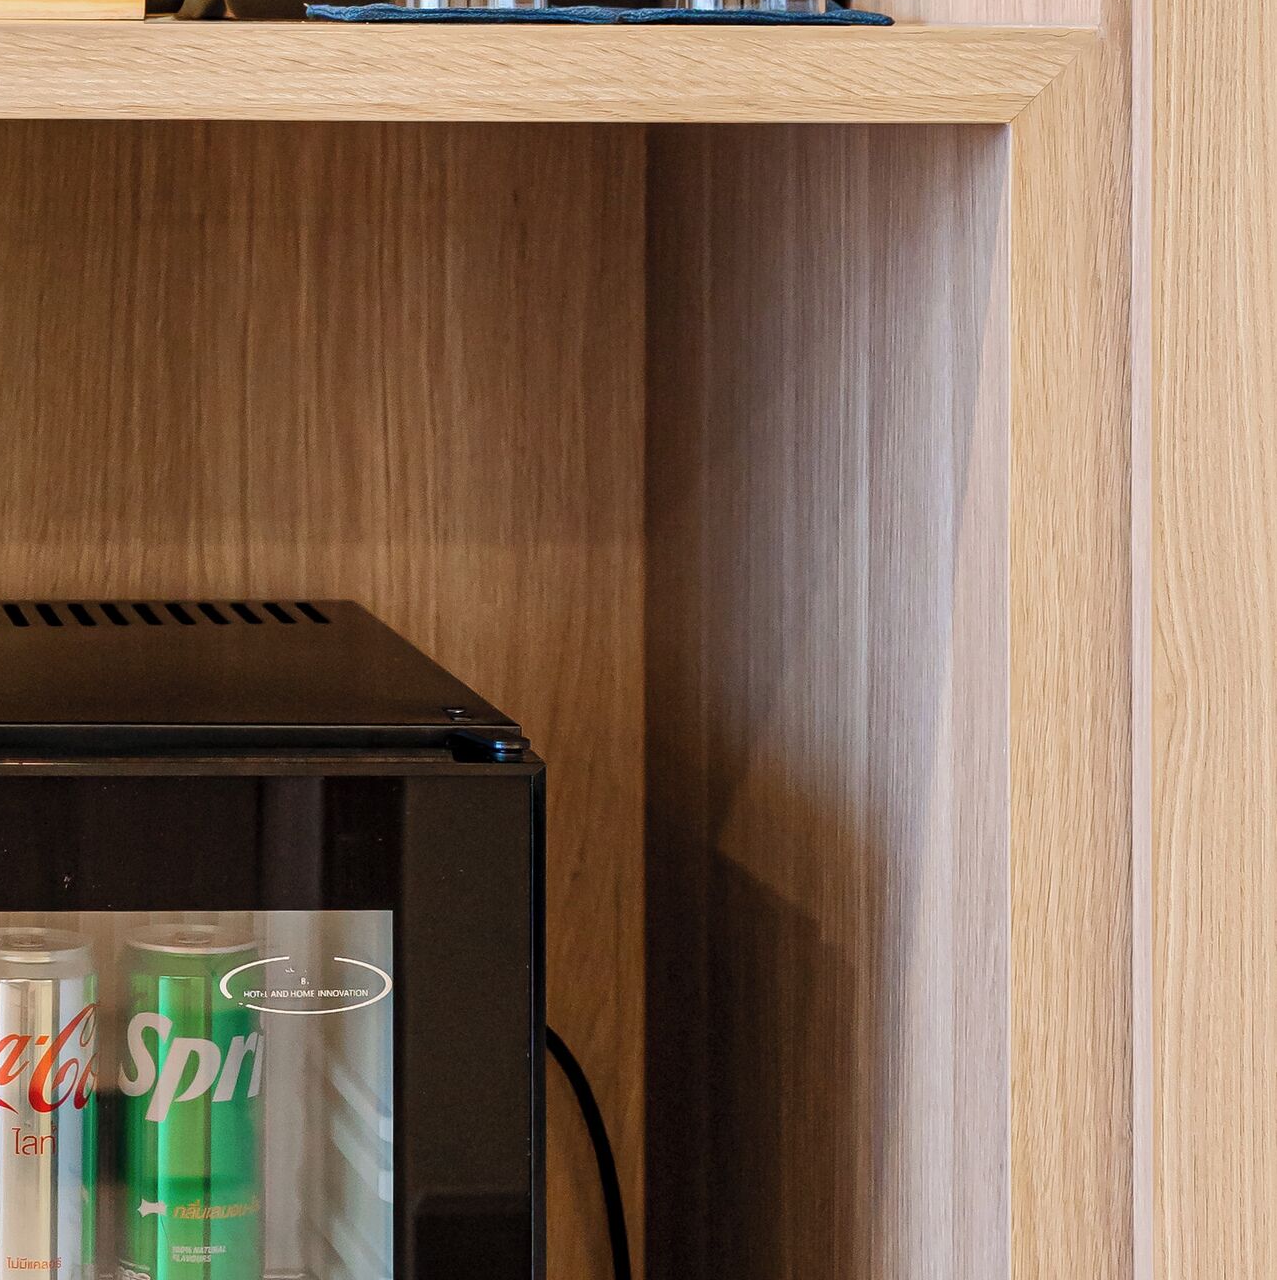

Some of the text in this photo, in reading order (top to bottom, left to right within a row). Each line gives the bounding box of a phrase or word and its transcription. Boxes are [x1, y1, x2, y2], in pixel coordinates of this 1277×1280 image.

[270, 990, 289, 998] AND
[290, 990, 315, 998] HOME
[317, 989, 369, 998] INNOVATION
